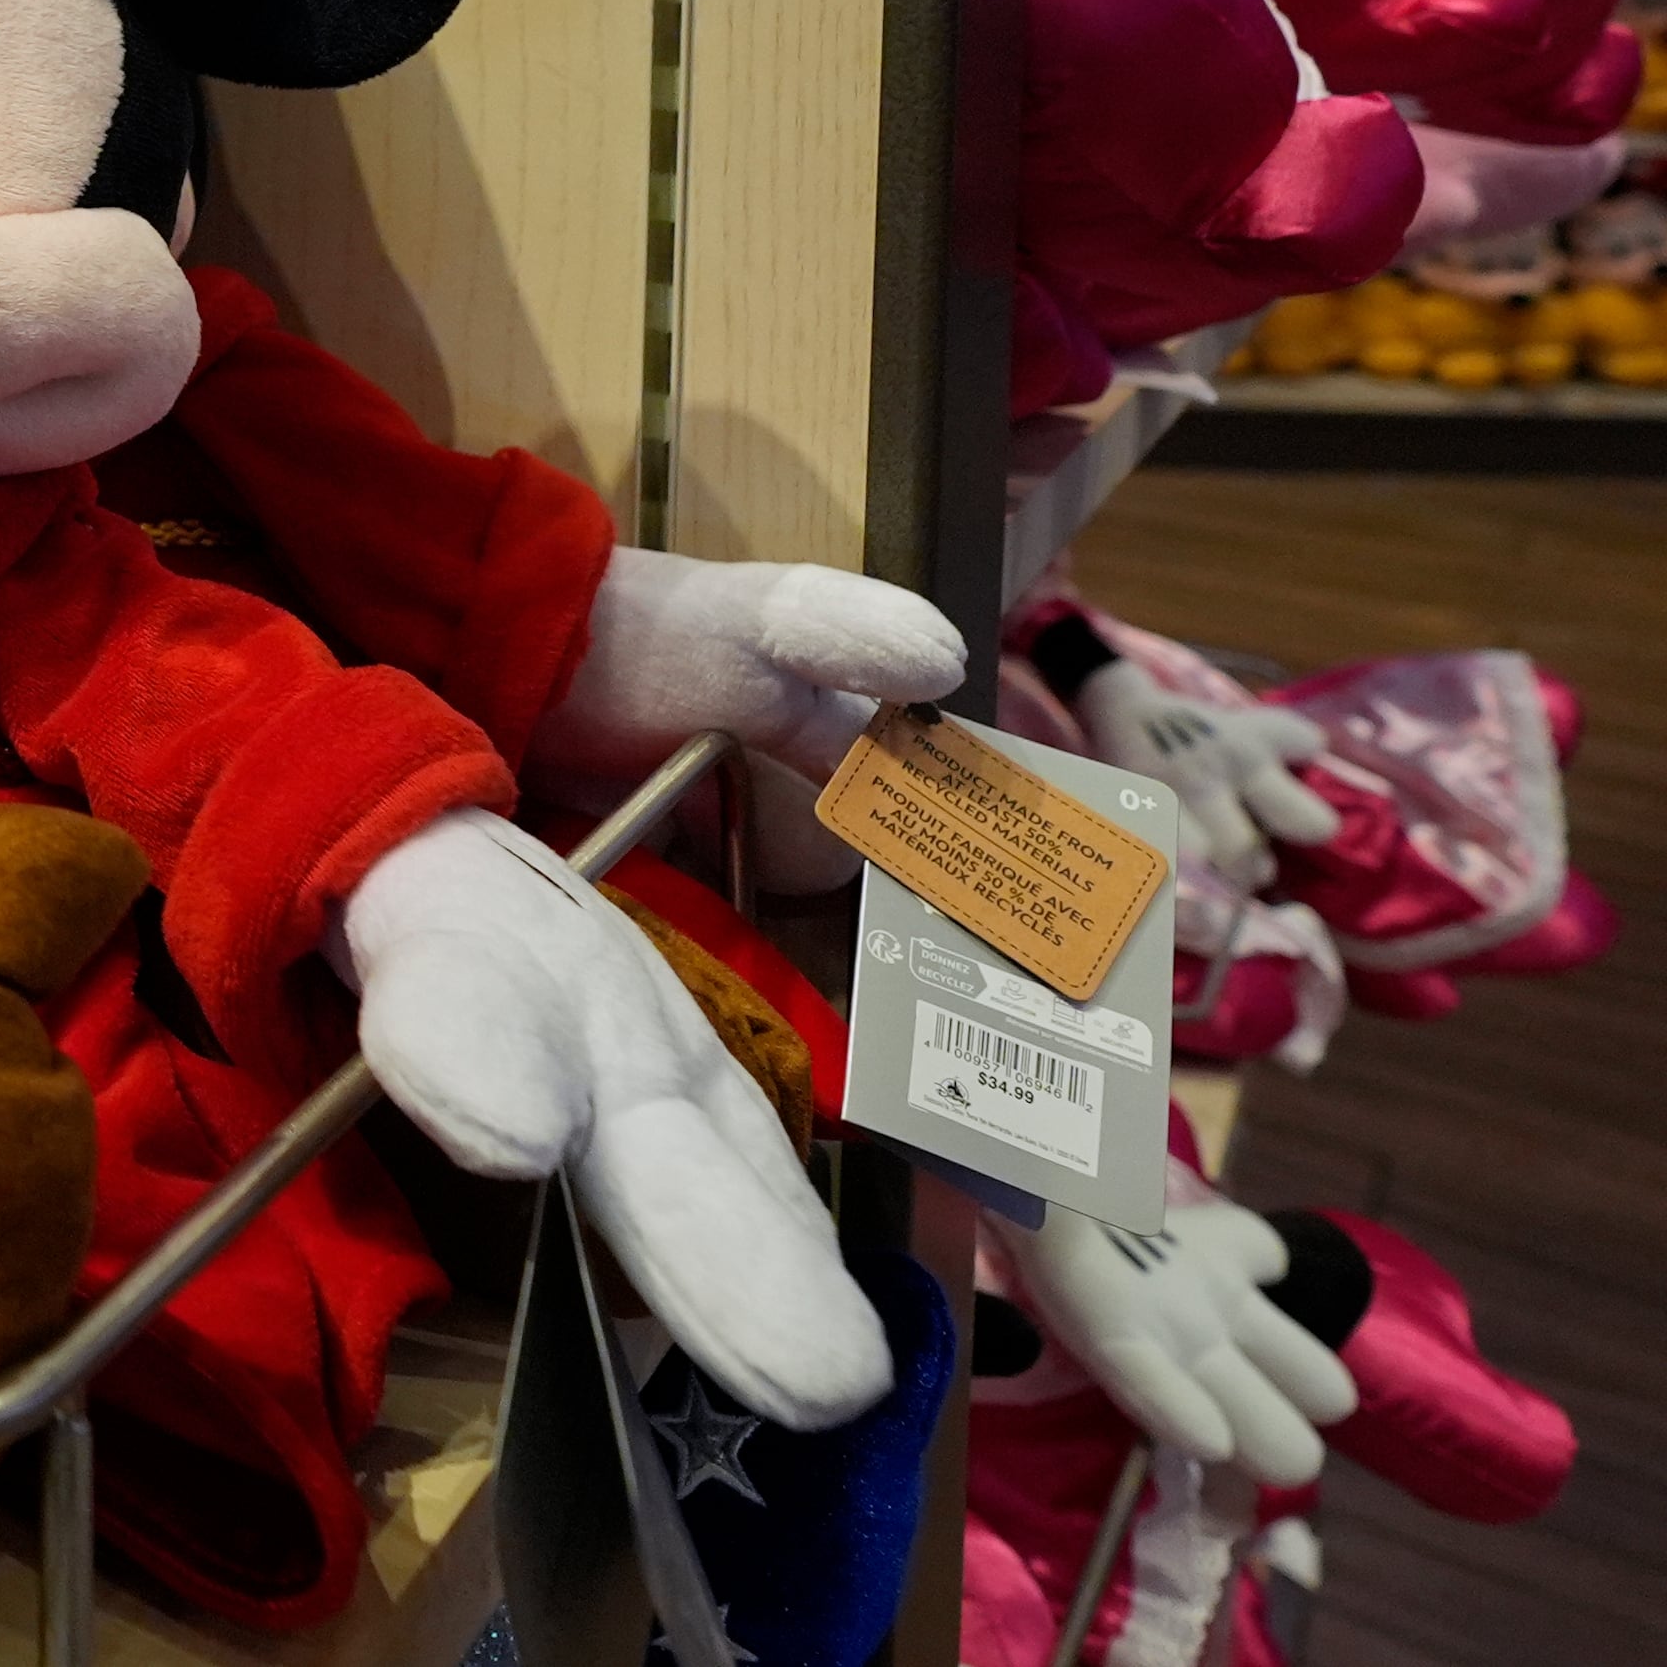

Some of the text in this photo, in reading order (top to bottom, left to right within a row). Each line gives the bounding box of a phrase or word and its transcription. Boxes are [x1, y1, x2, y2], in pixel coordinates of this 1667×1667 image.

[901, 757, 1094, 892] RECYCLED MATERIALS
[909, 732, 1113, 870] PRODUCT MADE FROM
[940, 773, 1062, 856] AT LEAST 50%
[1119, 788, 1158, 811] 0+
[869, 808, 1063, 946] MATÉRIAUX RECYCLÉS
[871, 775, 1094, 931] PRODUIT FABRIQUÉ AVEC
[889, 809, 1056, 927] AU MOINS 50 % DE
[918, 966, 975, 994] RECYCLEZ
[920, 949, 971, 975] DONNEZ
[924, 1039, 1094, 1114] 4 00957 06946 2
[934, 1081, 971, 1109] Disney
[978, 1071, 1034, 1103] $34.99
